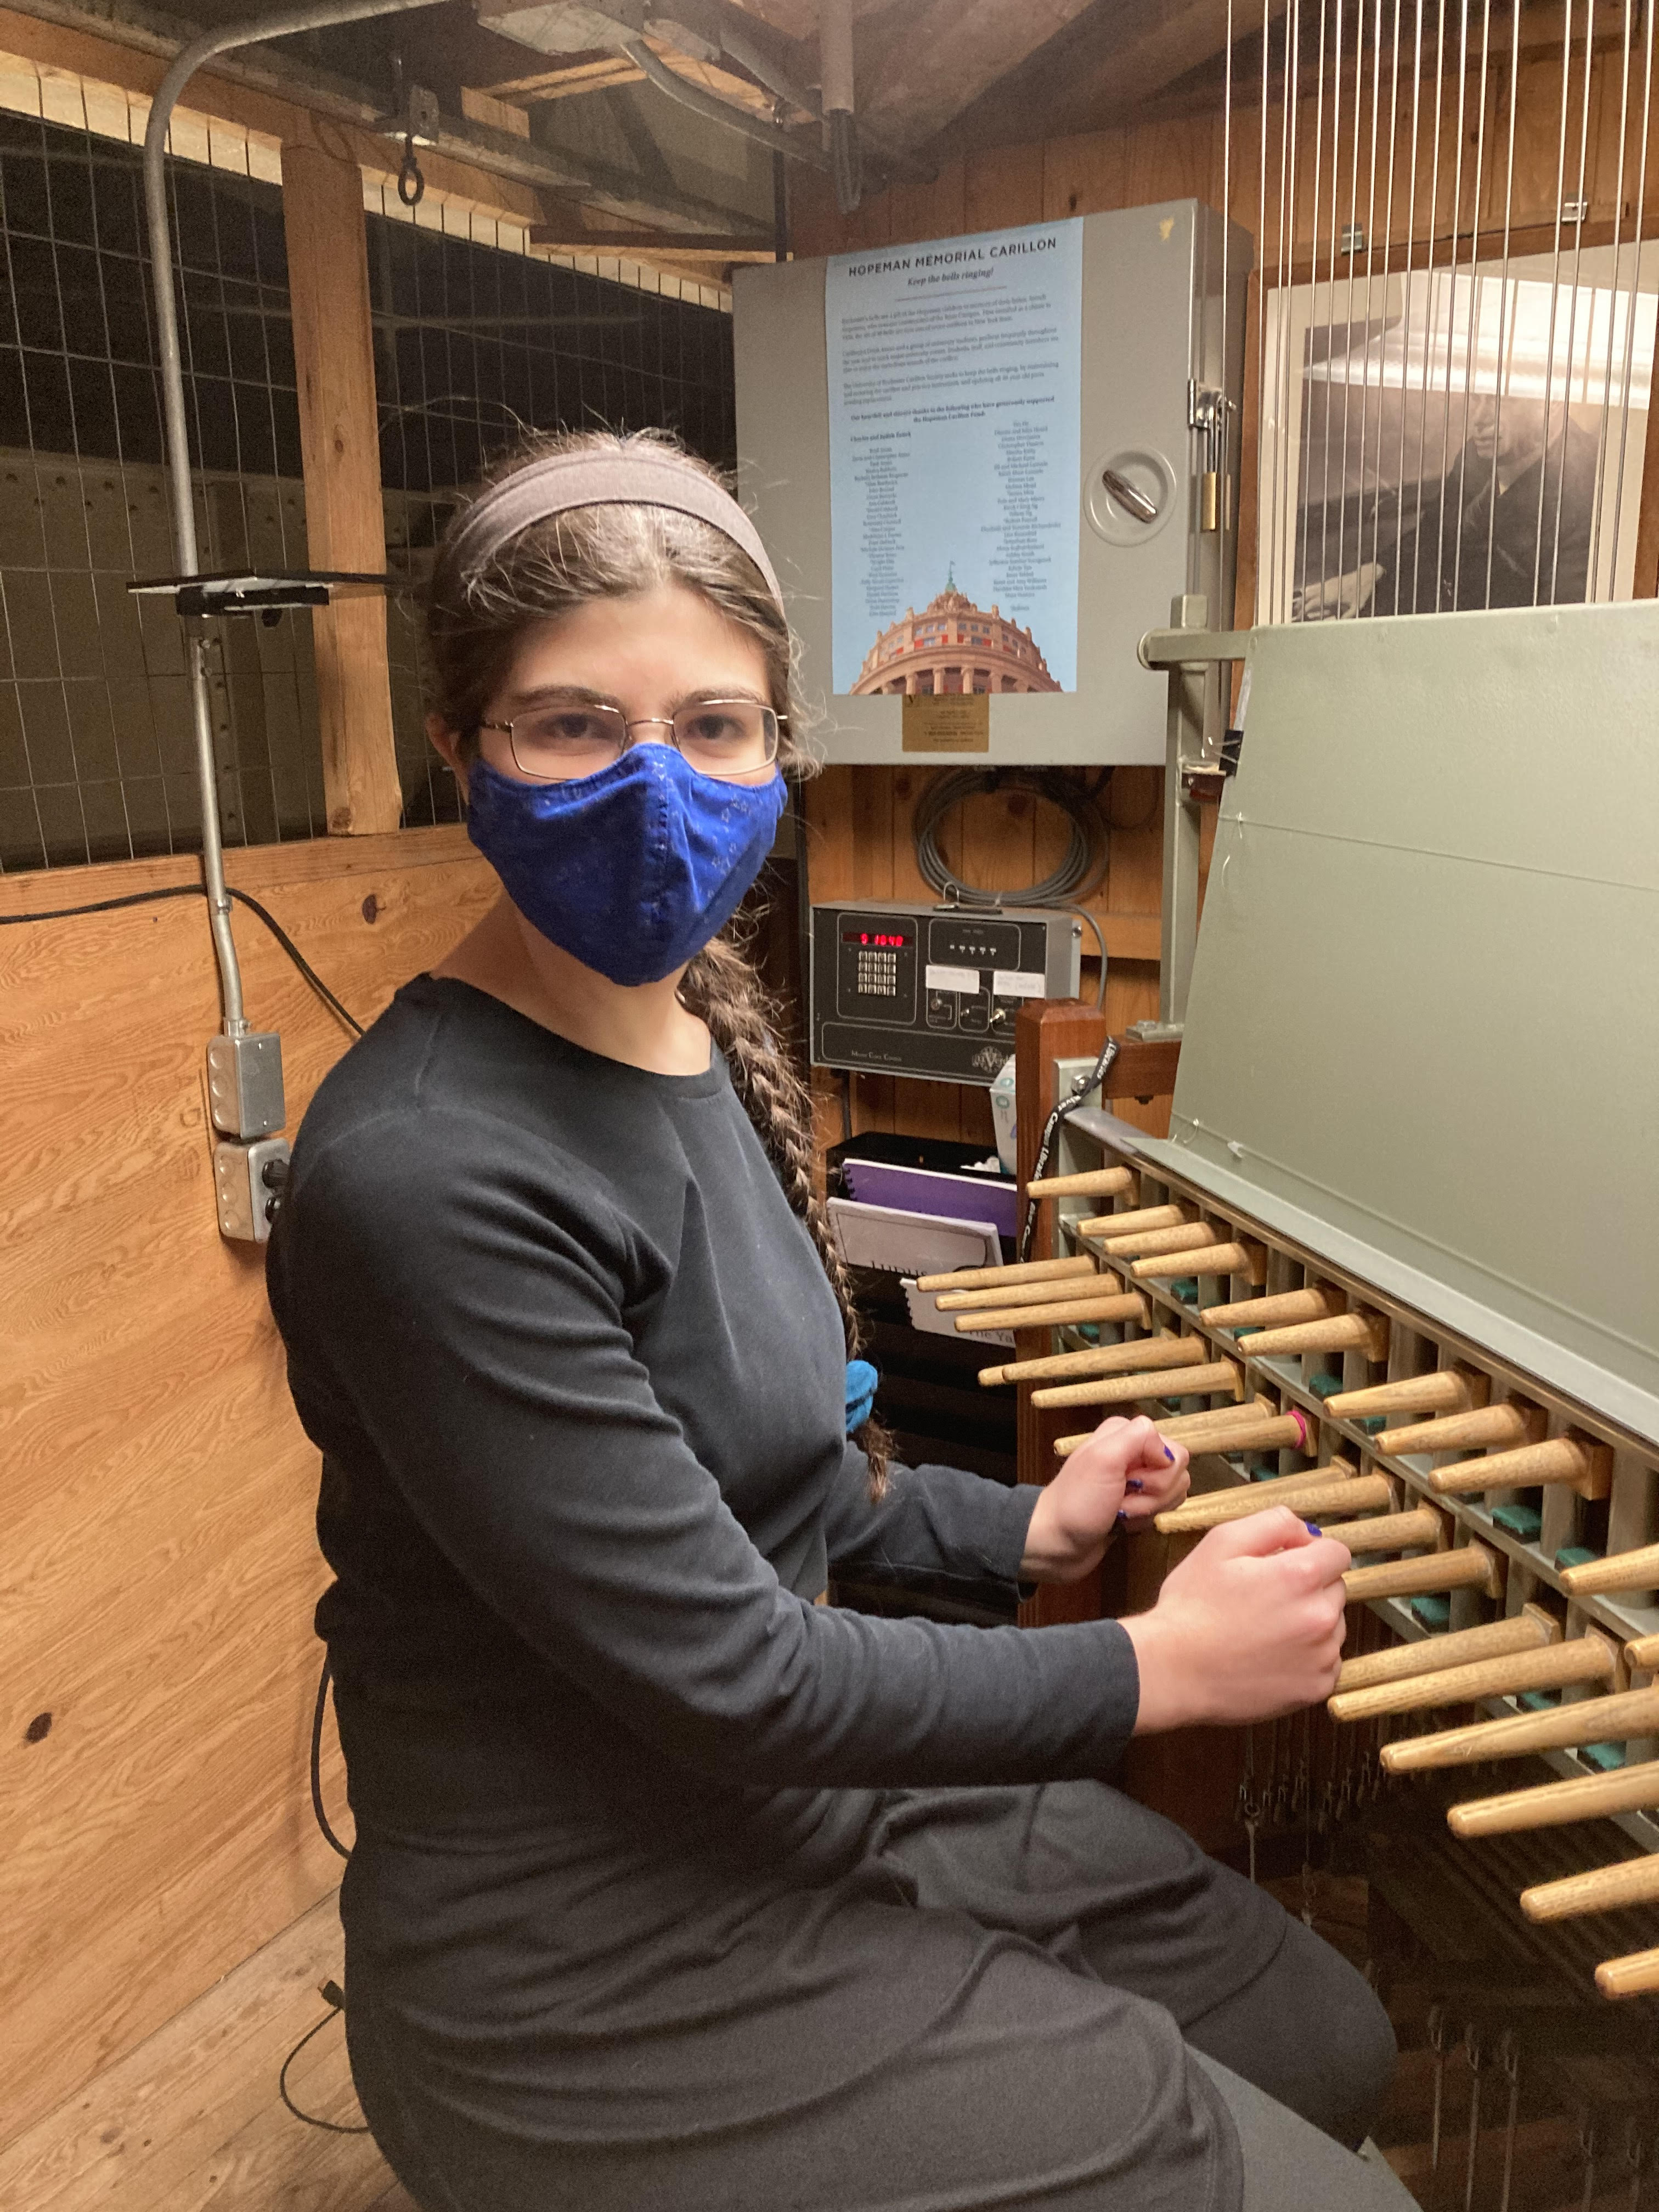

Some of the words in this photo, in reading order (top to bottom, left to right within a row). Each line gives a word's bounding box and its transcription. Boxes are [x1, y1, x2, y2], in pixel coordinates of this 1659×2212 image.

[849, 258, 911, 276] HOPEMAN
[916, 248, 985, 268] MEMORIAL
[990, 237, 1056, 258] CARILLON
[908, 276, 927, 287] Keep
[928, 275, 940, 283] the
[941, 271, 960, 282] bells
[961, 267, 994, 280] ringing!
